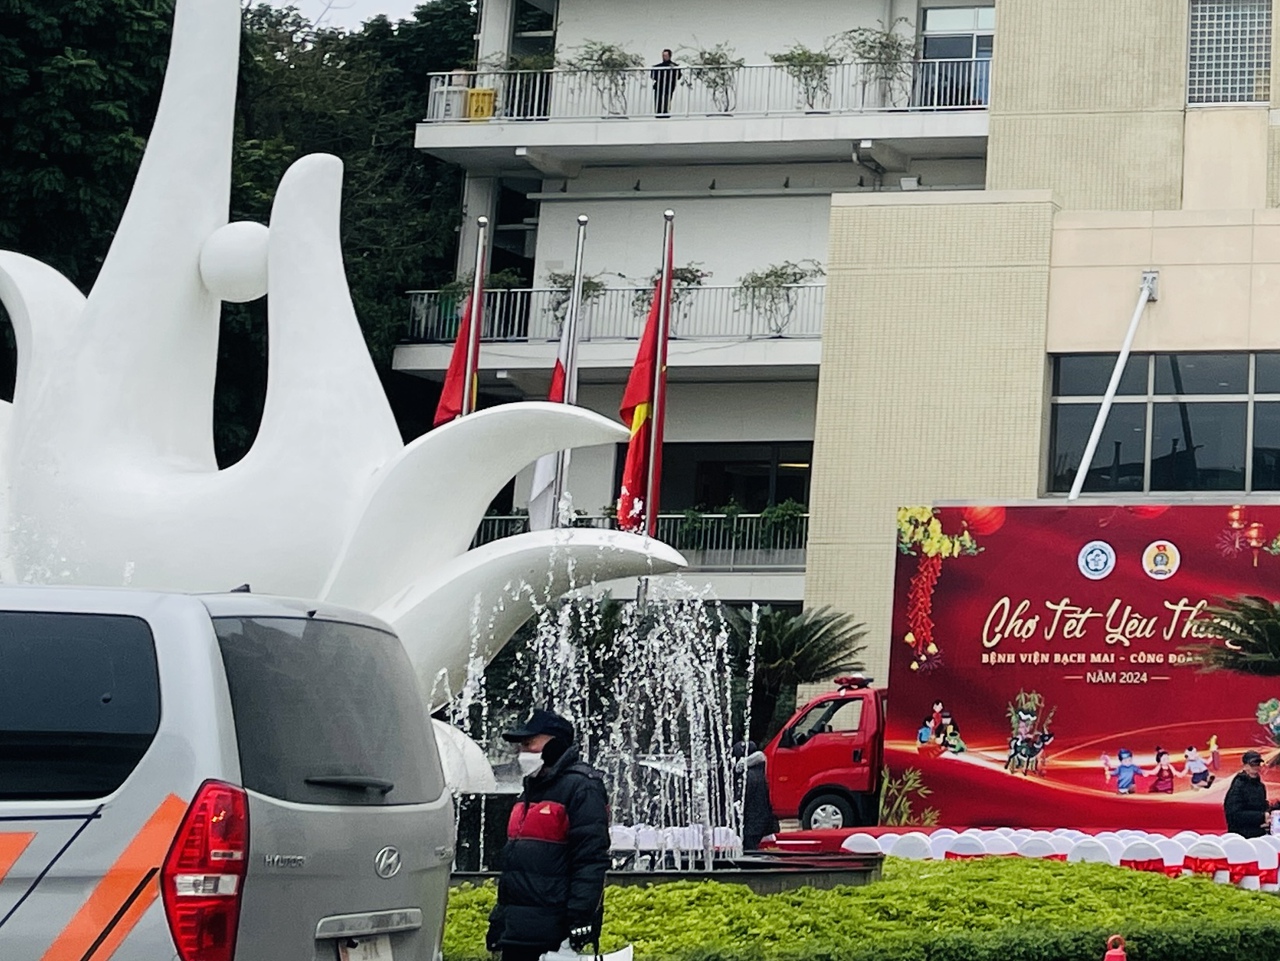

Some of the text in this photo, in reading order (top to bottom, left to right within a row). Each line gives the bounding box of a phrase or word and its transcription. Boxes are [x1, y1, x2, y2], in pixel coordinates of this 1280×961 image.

[982, 596, 1039, 648] Chợ
[1044, 597, 1104, 640] Tết
[1104, 598, 1159, 647] Yêu
[982, 651, 1016, 666] BỆNH
[1019, 651, 1050, 666] VIỆN
[1053, 653, 1086, 666] BẠCH
[1090, 653, 1115, 664] MAI
[1129, 651, 1164, 664] CÔNG
[1168, 651, 1203, 664] ĐOÀ
[1086, 669, 1148, 683] NĂM 2024
